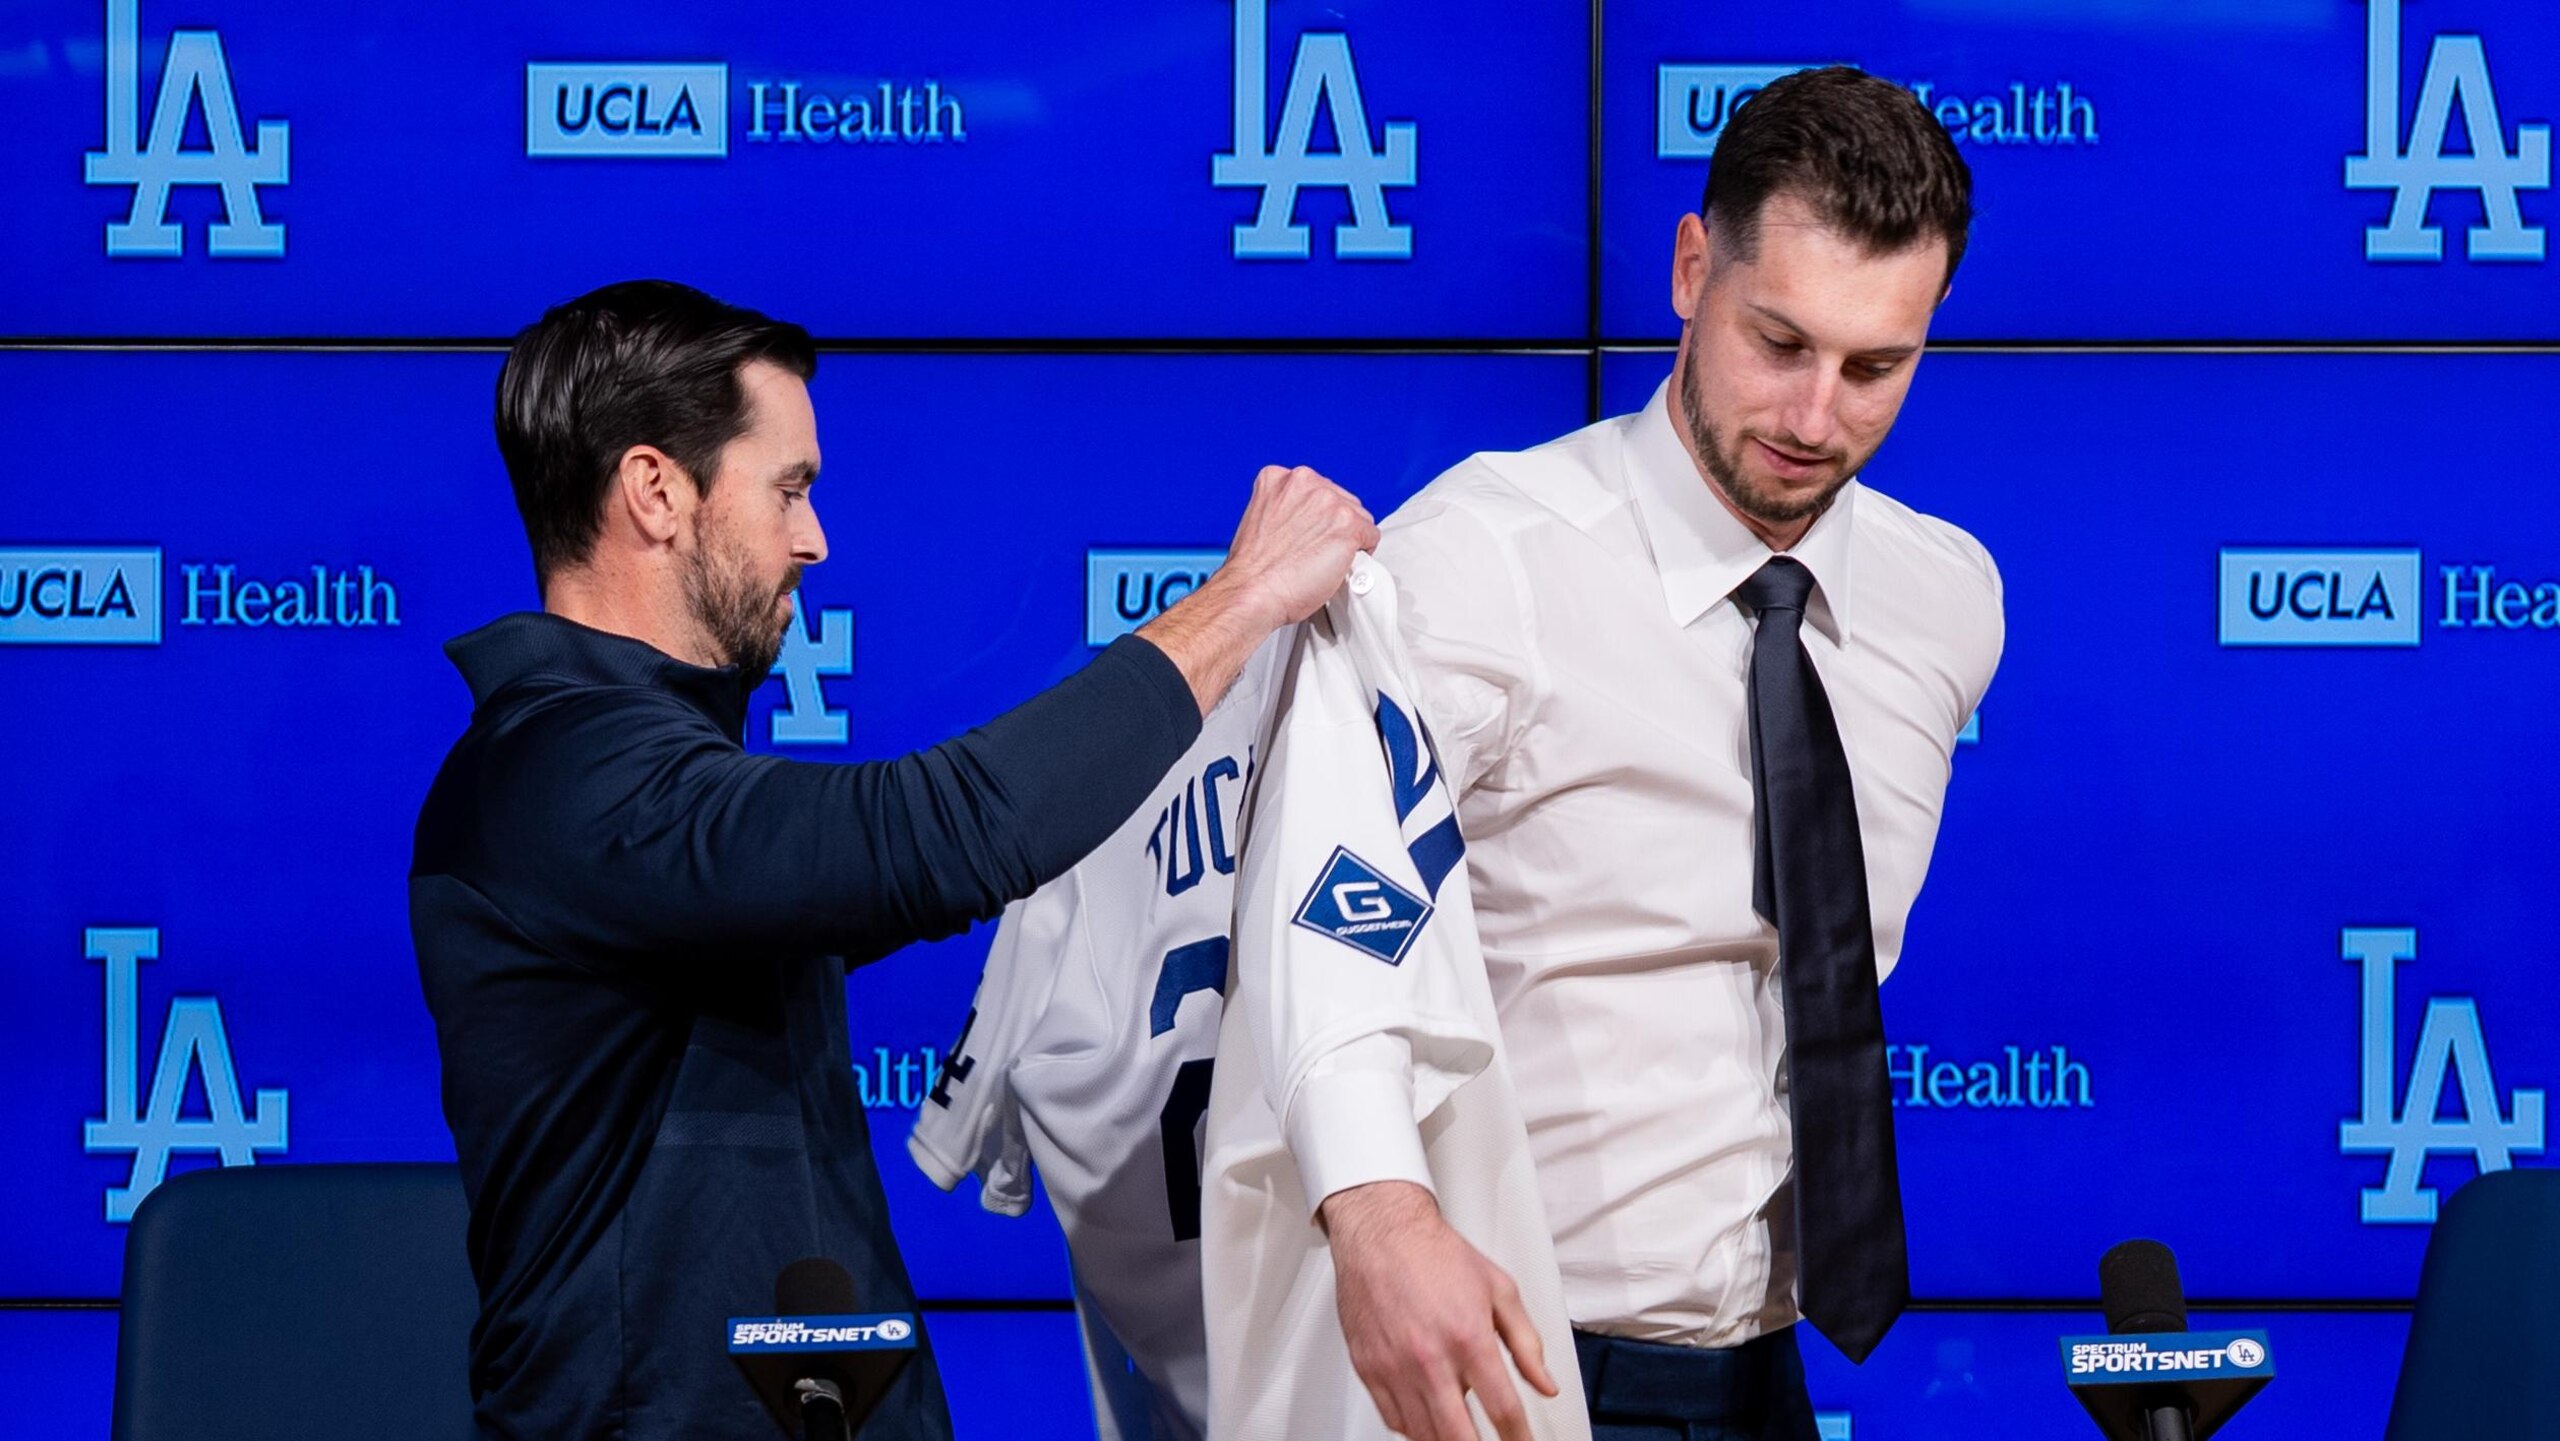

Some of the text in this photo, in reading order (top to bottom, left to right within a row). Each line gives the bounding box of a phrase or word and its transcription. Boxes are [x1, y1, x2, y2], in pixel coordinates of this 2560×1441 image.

[85, 0, 290, 257] LA
[557, 80, 967, 143] UCLA Health
[1212, 0, 1417, 259] LA
[1910, 82, 2099, 144] ealth
[2344, 0, 2551, 261] LA
[181, 564, 401, 626] Health
[1117, 572, 1209, 621] UC
[2249, 571, 2395, 621] UCLA
[1145, 745, 1254, 897] TUC
[1332, 882, 1391, 921] G
[1886, 1045, 2094, 1107] Health
[733, 1327, 876, 1345] SPORTSNET
[736, 1323, 805, 1333] SPECTRUM
[2072, 1343, 2147, 1355] SPECTRUM
[2072, 1350, 2227, 1373] SPORTSNET
